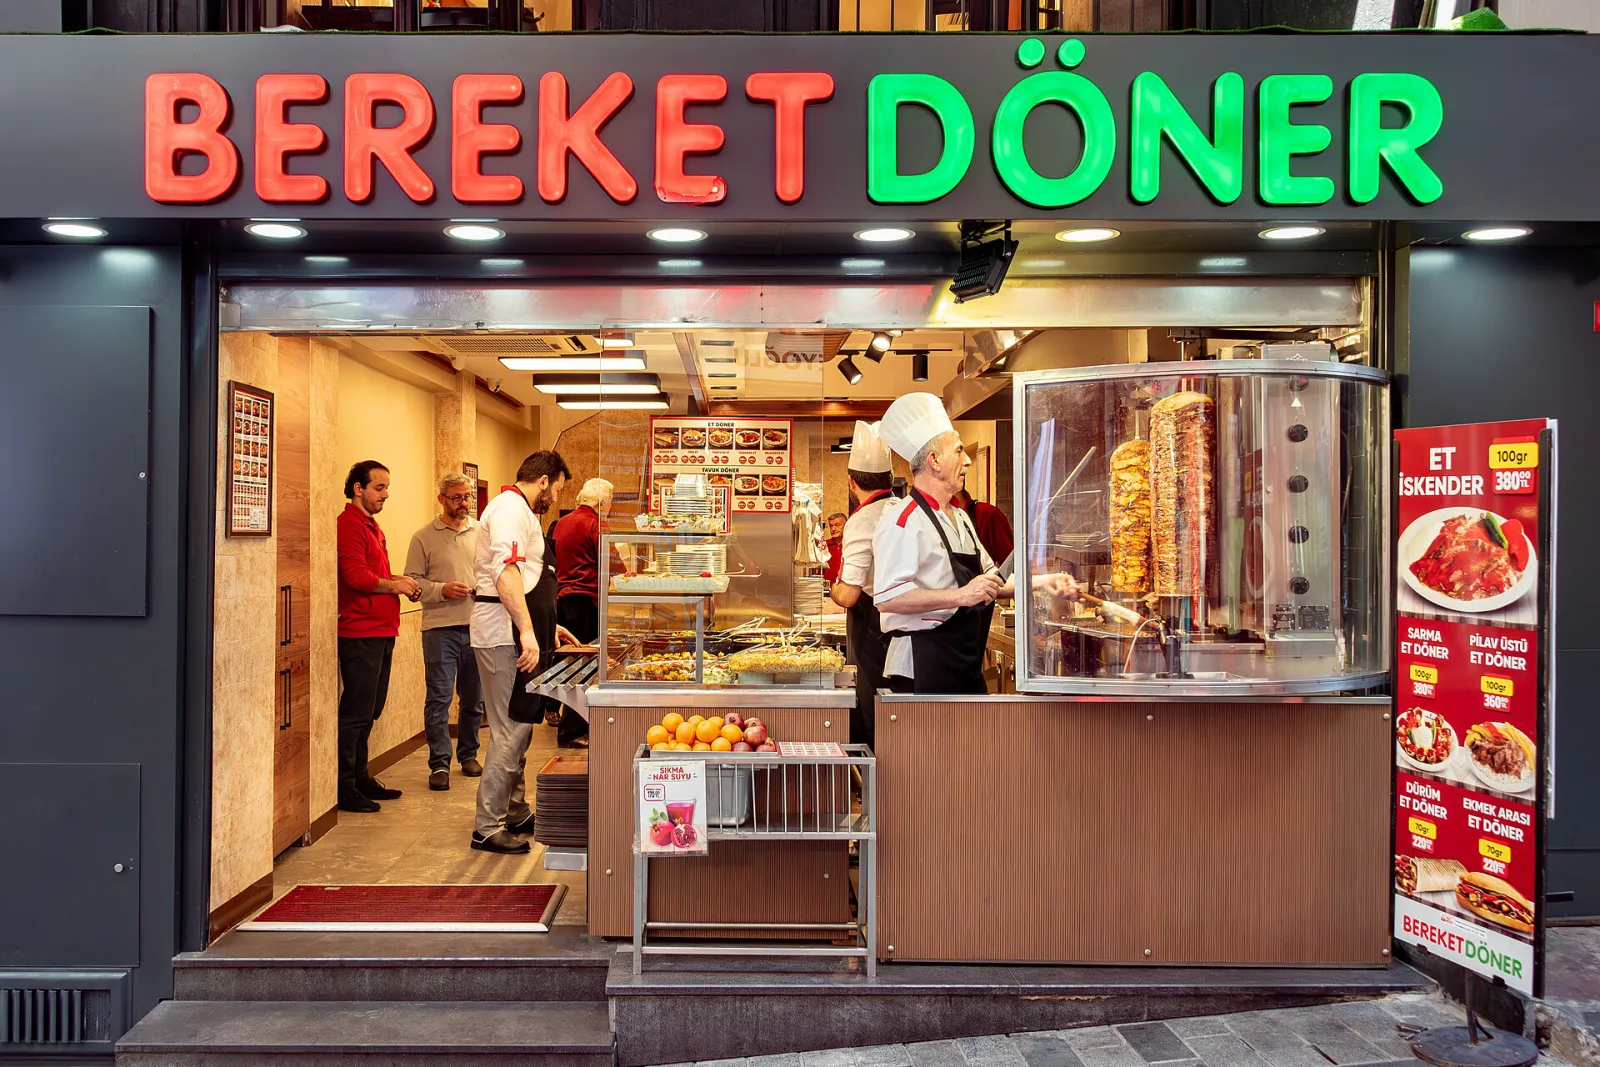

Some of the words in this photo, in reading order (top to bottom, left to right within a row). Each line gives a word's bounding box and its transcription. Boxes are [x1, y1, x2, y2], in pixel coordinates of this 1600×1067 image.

[144, 71, 835, 205] BEREKET
[866, 37, 1444, 208] DÖNER
[1429, 446, 1456, 471] ET
[1497, 450, 1528, 465] 100gr
[1399, 472, 1485, 496] İSKENDER
[1407, 627, 1442, 643] SARMA
[1469, 632, 1498, 649] PİLAV
[1499, 635, 1528, 653] ÜSTÜ
[1401, 642, 1412, 655] ET
[1414, 642, 1449, 660] DÖNER
[1470, 651, 1483, 665] ET
[1485, 651, 1527, 671] DÖNER
[1414, 669, 1432, 681] 100gr
[1486, 681, 1507, 693] 100gr
[652, 773, 669, 781] NAR
[659, 766, 685, 774] SIKMA
[1405, 781, 1441, 802] DÜRÜM
[1399, 795, 1411, 808] ET
[1412, 797, 1448, 820] DÖNER
[1462, 797, 1497, 817] EKMEK
[1498, 807, 1531, 827] ARASI
[1415, 823, 1429, 835] 70gr
[1468, 814, 1482, 830] ET
[1483, 818, 1525, 843] DÖNER
[1486, 844, 1504, 858] 70gr
